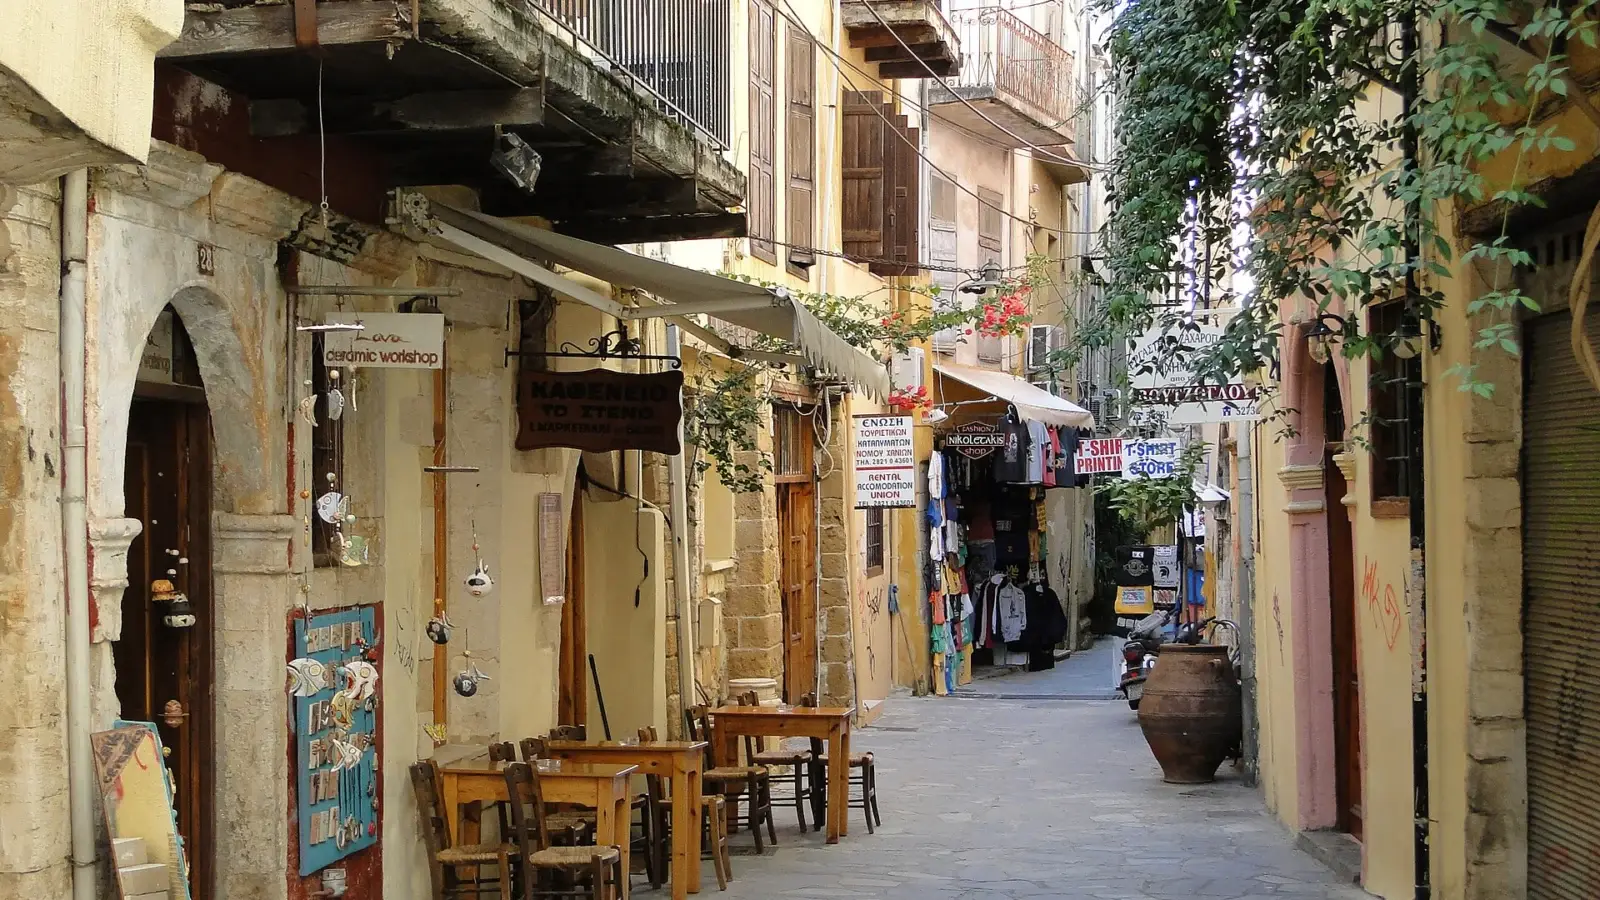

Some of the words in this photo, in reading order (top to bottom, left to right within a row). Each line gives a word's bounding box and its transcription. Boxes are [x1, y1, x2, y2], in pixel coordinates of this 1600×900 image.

[200, 248, 213, 271] 28
[326, 349, 377, 362] ceramic
[379, 349, 438, 366] workshop
[862, 417, 904, 427] ΕΝΩΣΗ
[860, 428, 908, 437] ΤΟΥΡΙΣΤΙΚΩΝ
[856, 449, 884, 458] ΝΟΜΟΥ
[886, 448, 913, 457] ΧΑΝΙΩΝ
[964, 447, 987, 455] shop
[1078, 439, 1122, 457] T-SHIR
[1125, 442, 1177, 456] T-SHRT
[1077, 456, 1122, 472] PRINTIN
[1129, 461, 1175, 475] STORE
[868, 473, 902, 481] RENTAL
[857, 482, 913, 491] ACCOMODATION
[870, 491, 900, 499] UNION
